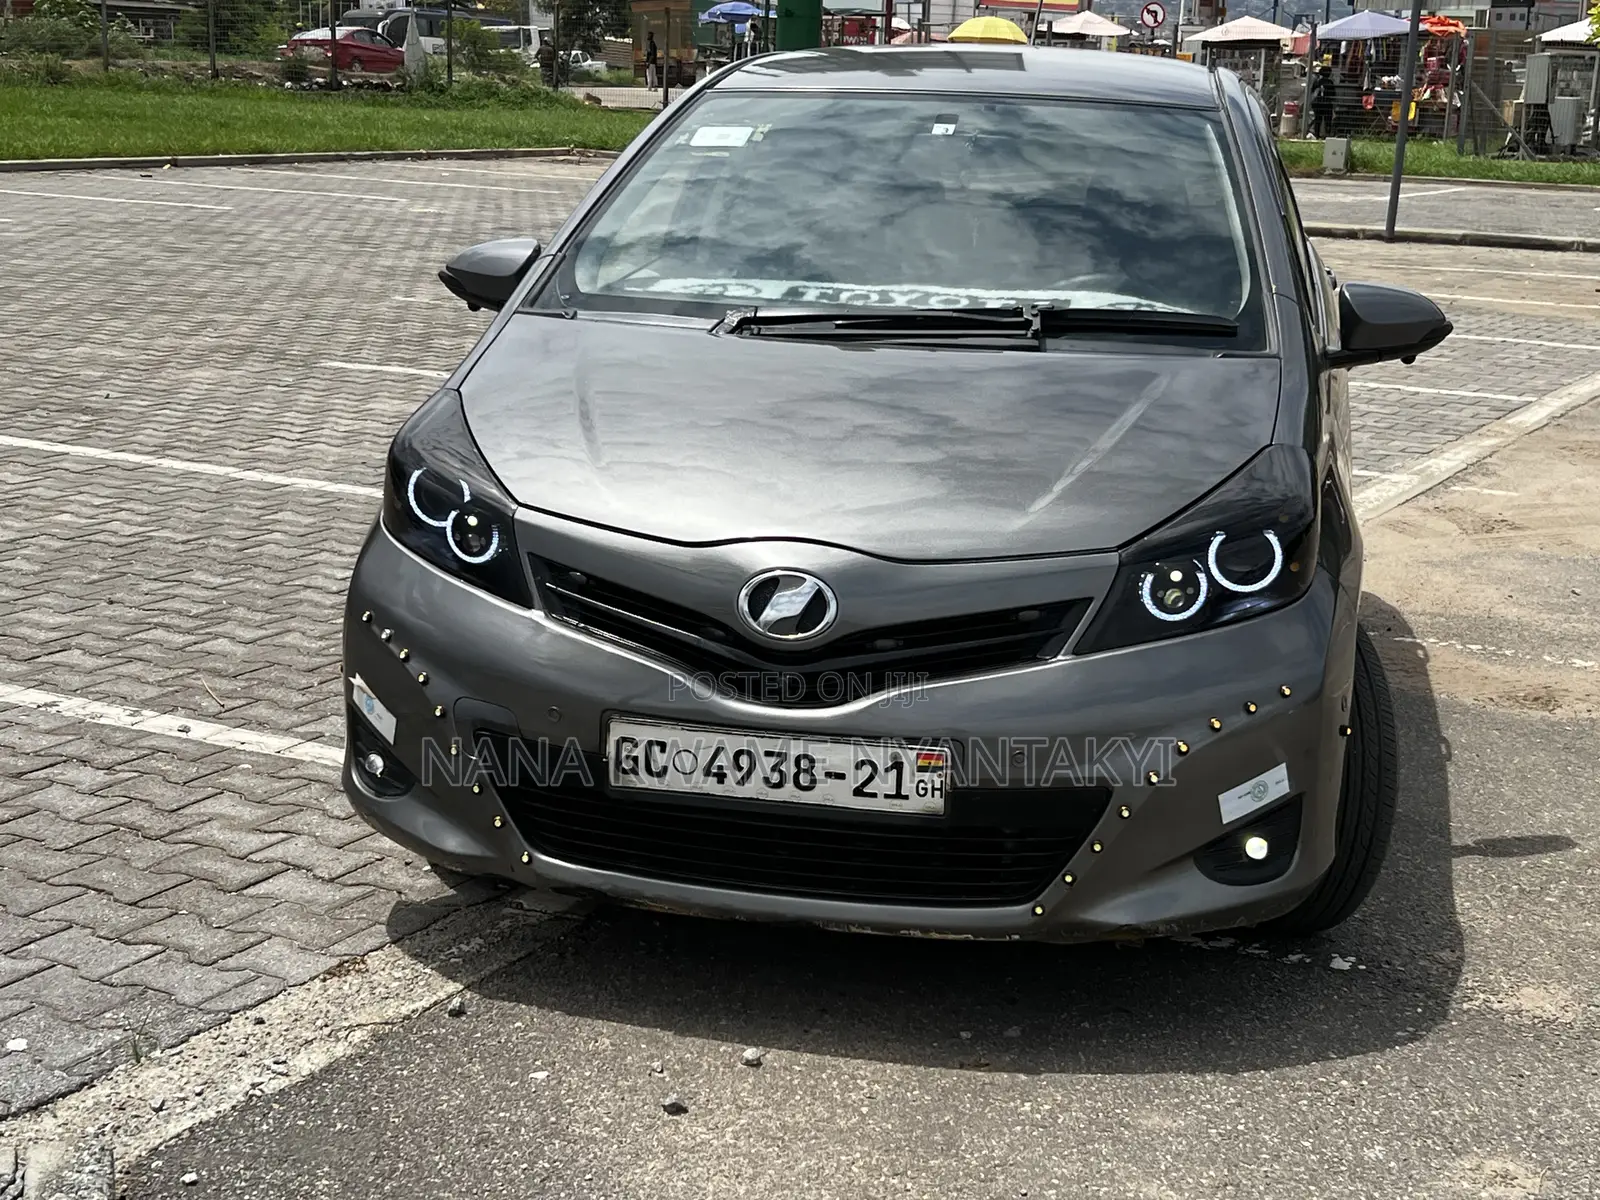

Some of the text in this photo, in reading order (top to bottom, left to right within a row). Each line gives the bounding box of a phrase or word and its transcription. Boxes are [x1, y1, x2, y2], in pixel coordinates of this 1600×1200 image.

[615, 736, 910, 800] GC 4938-21
[915, 779, 944, 798] GH
